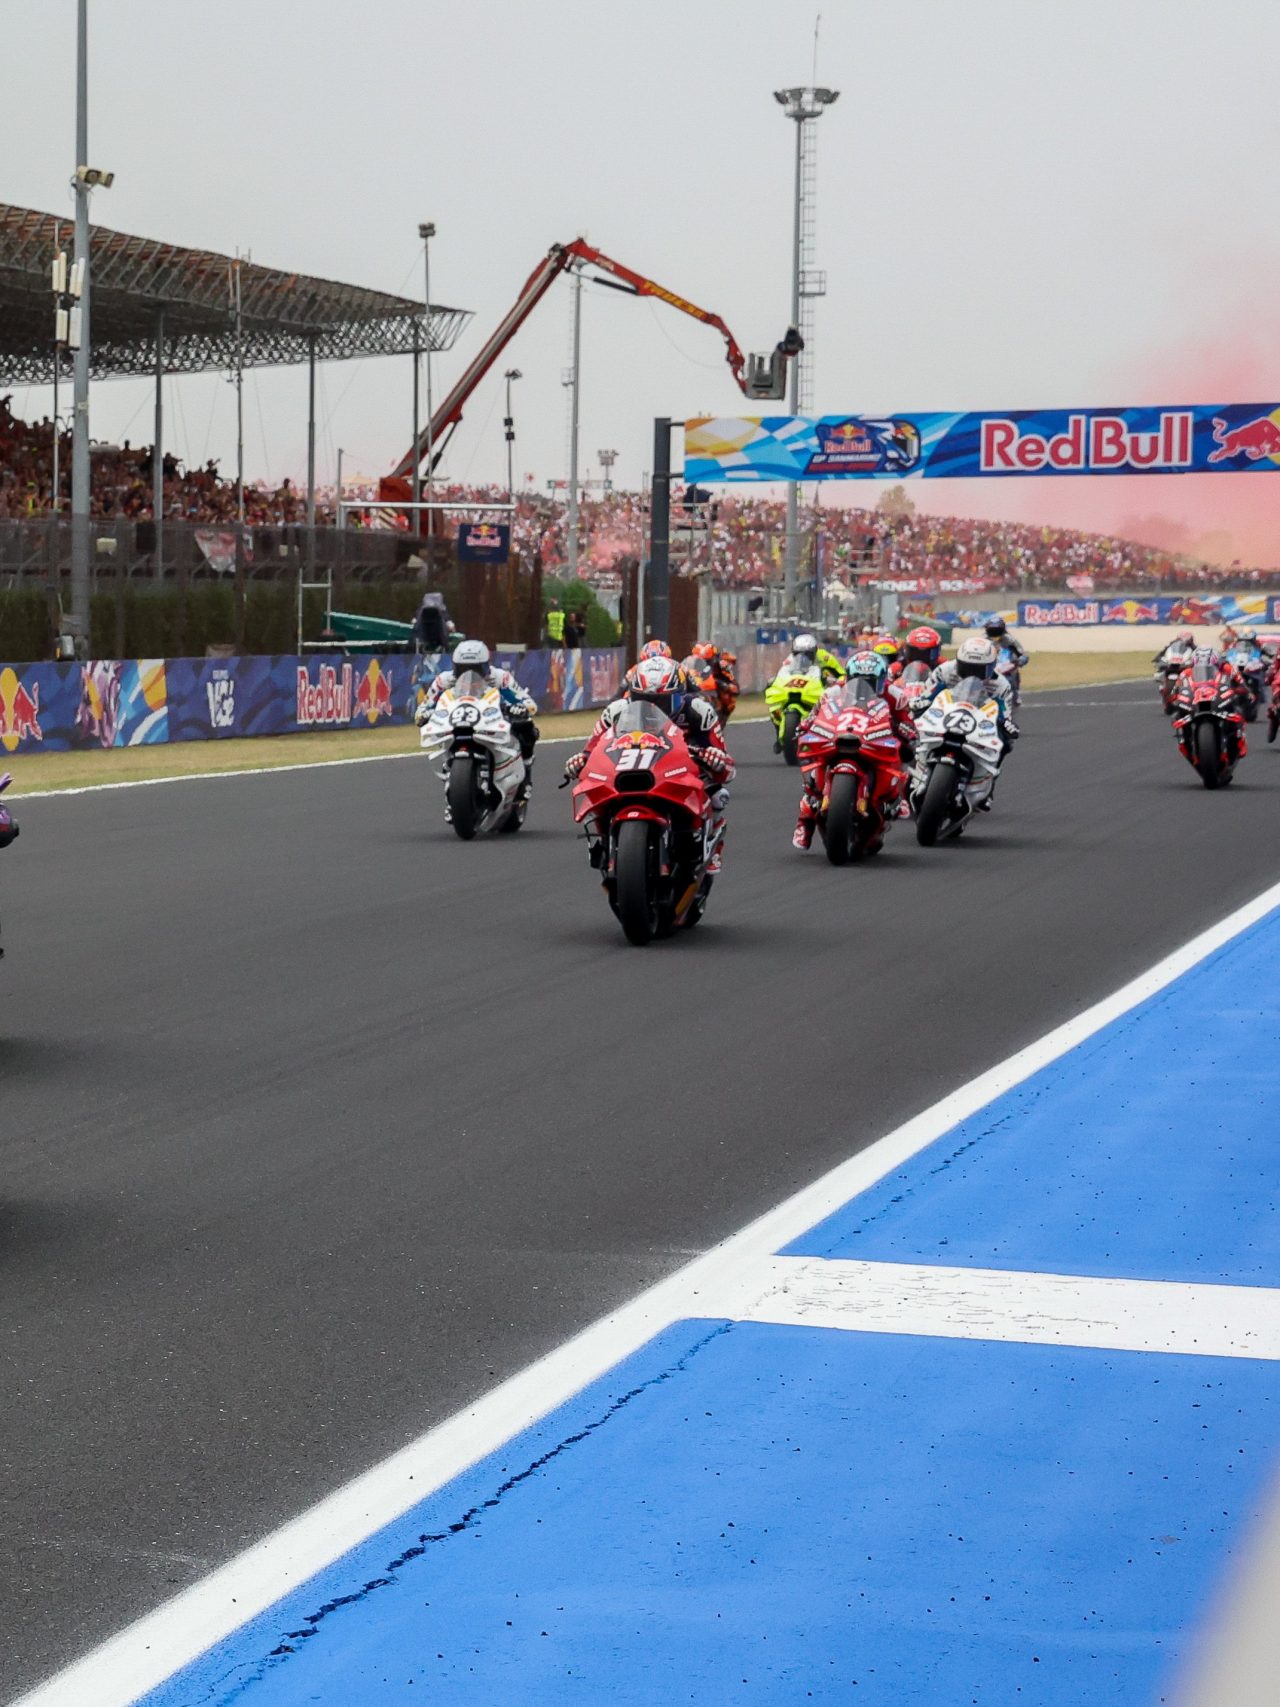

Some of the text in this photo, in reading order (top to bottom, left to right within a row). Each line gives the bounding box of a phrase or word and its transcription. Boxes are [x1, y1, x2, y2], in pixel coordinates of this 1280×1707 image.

[980, 411, 1194, 472] Red Bull
[1025, 602, 1098, 624] Red Bull
[297, 666, 323, 724] Red
[323, 663, 352, 722] Bull
[452, 710, 478, 723] 93
[837, 712, 869, 732] 23
[946, 711, 975, 732] 73
[615, 749, 657, 770] 31
